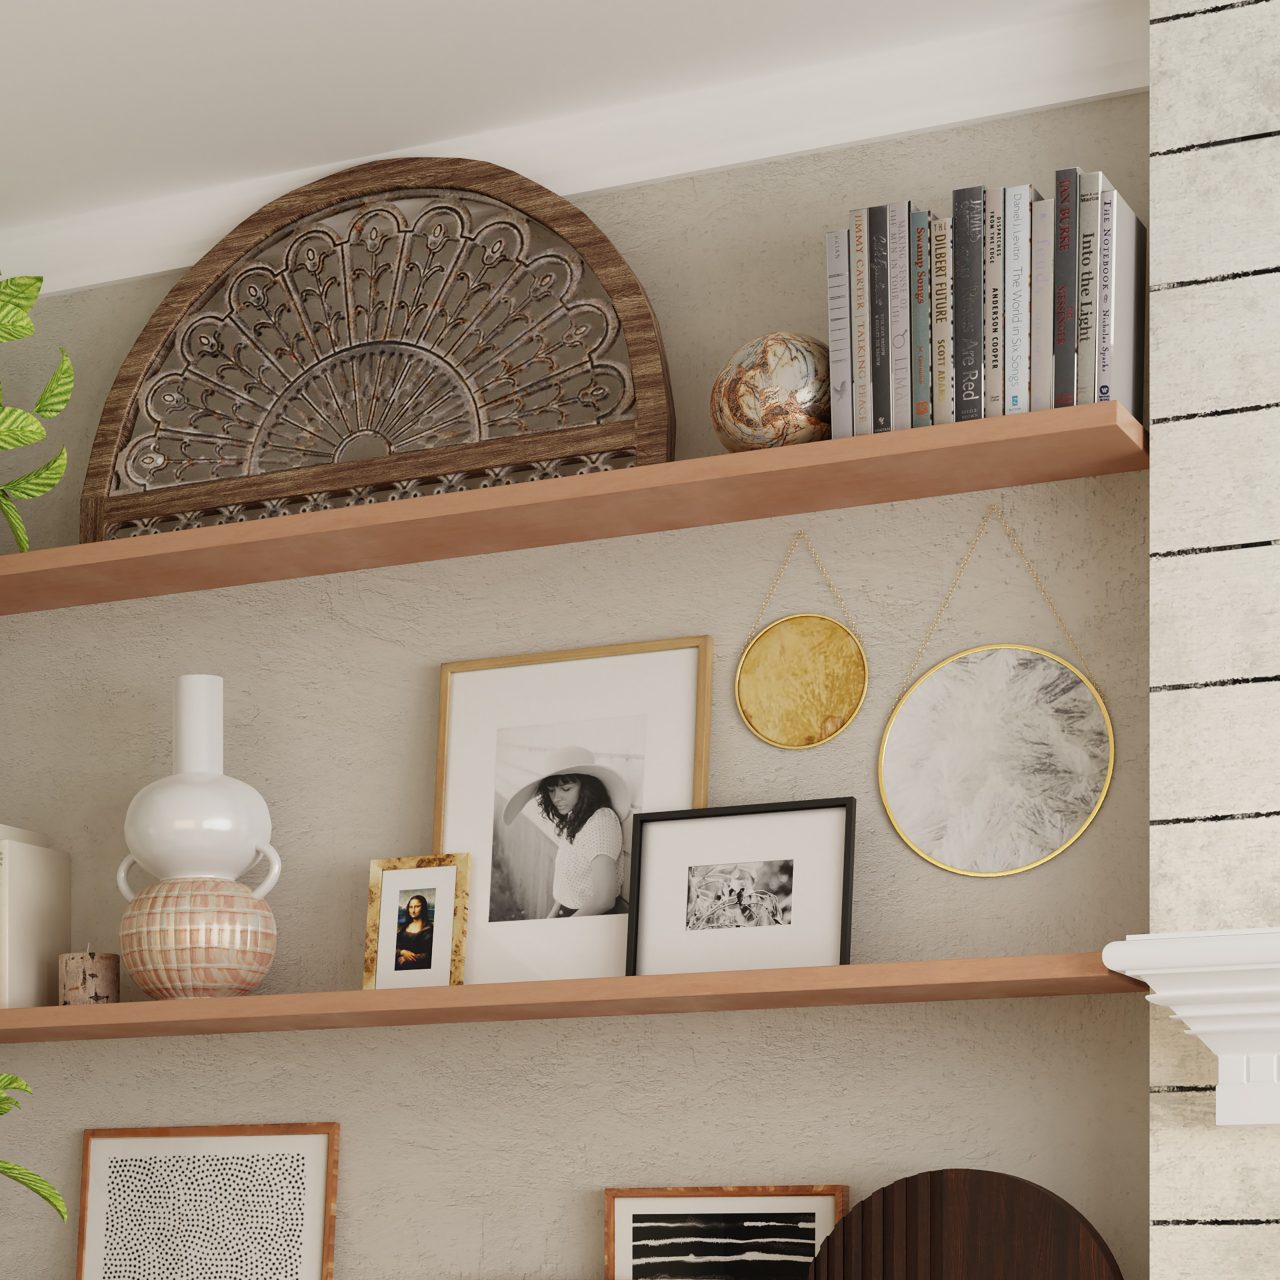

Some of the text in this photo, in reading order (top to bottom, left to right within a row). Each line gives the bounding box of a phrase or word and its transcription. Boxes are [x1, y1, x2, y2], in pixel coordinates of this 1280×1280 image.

[1012, 193, 1022, 220] Daniel
[1056, 180, 1072, 253] JAN BURKE
[897, 220, 906, 260] MAKING
[933, 221, 946, 232] THE
[890, 232, 898, 253] MEN
[1012, 230, 1022, 261] Levitin
[891, 259, 898, 270] IN
[898, 263, 907, 293] SENSE
[915, 227, 926, 304] Swamp Songs
[934, 234, 947, 324] DILBERT FUTURE
[1012, 266, 1023, 288] The
[891, 274, 899, 300] YOUR
[1078, 232, 1095, 343] Into the Light
[1100, 200, 1111, 372] THE NOTEBOOK Nicholas Sparks
[854, 213, 867, 423] JIMMY CARTER TALKING PEACE
[1011, 289, 1023, 323] World
[1057, 285, 1066, 345] MESSENGER
[991, 287, 999, 369] ANDERSON COOPER
[1012, 326, 1020, 336] in
[937, 339, 946, 367] SCOTT
[962, 339, 979, 367] Are
[1011, 338, 1022, 353] Six
[962, 369, 980, 401] Red
[1008, 355, 1022, 387] Songs
